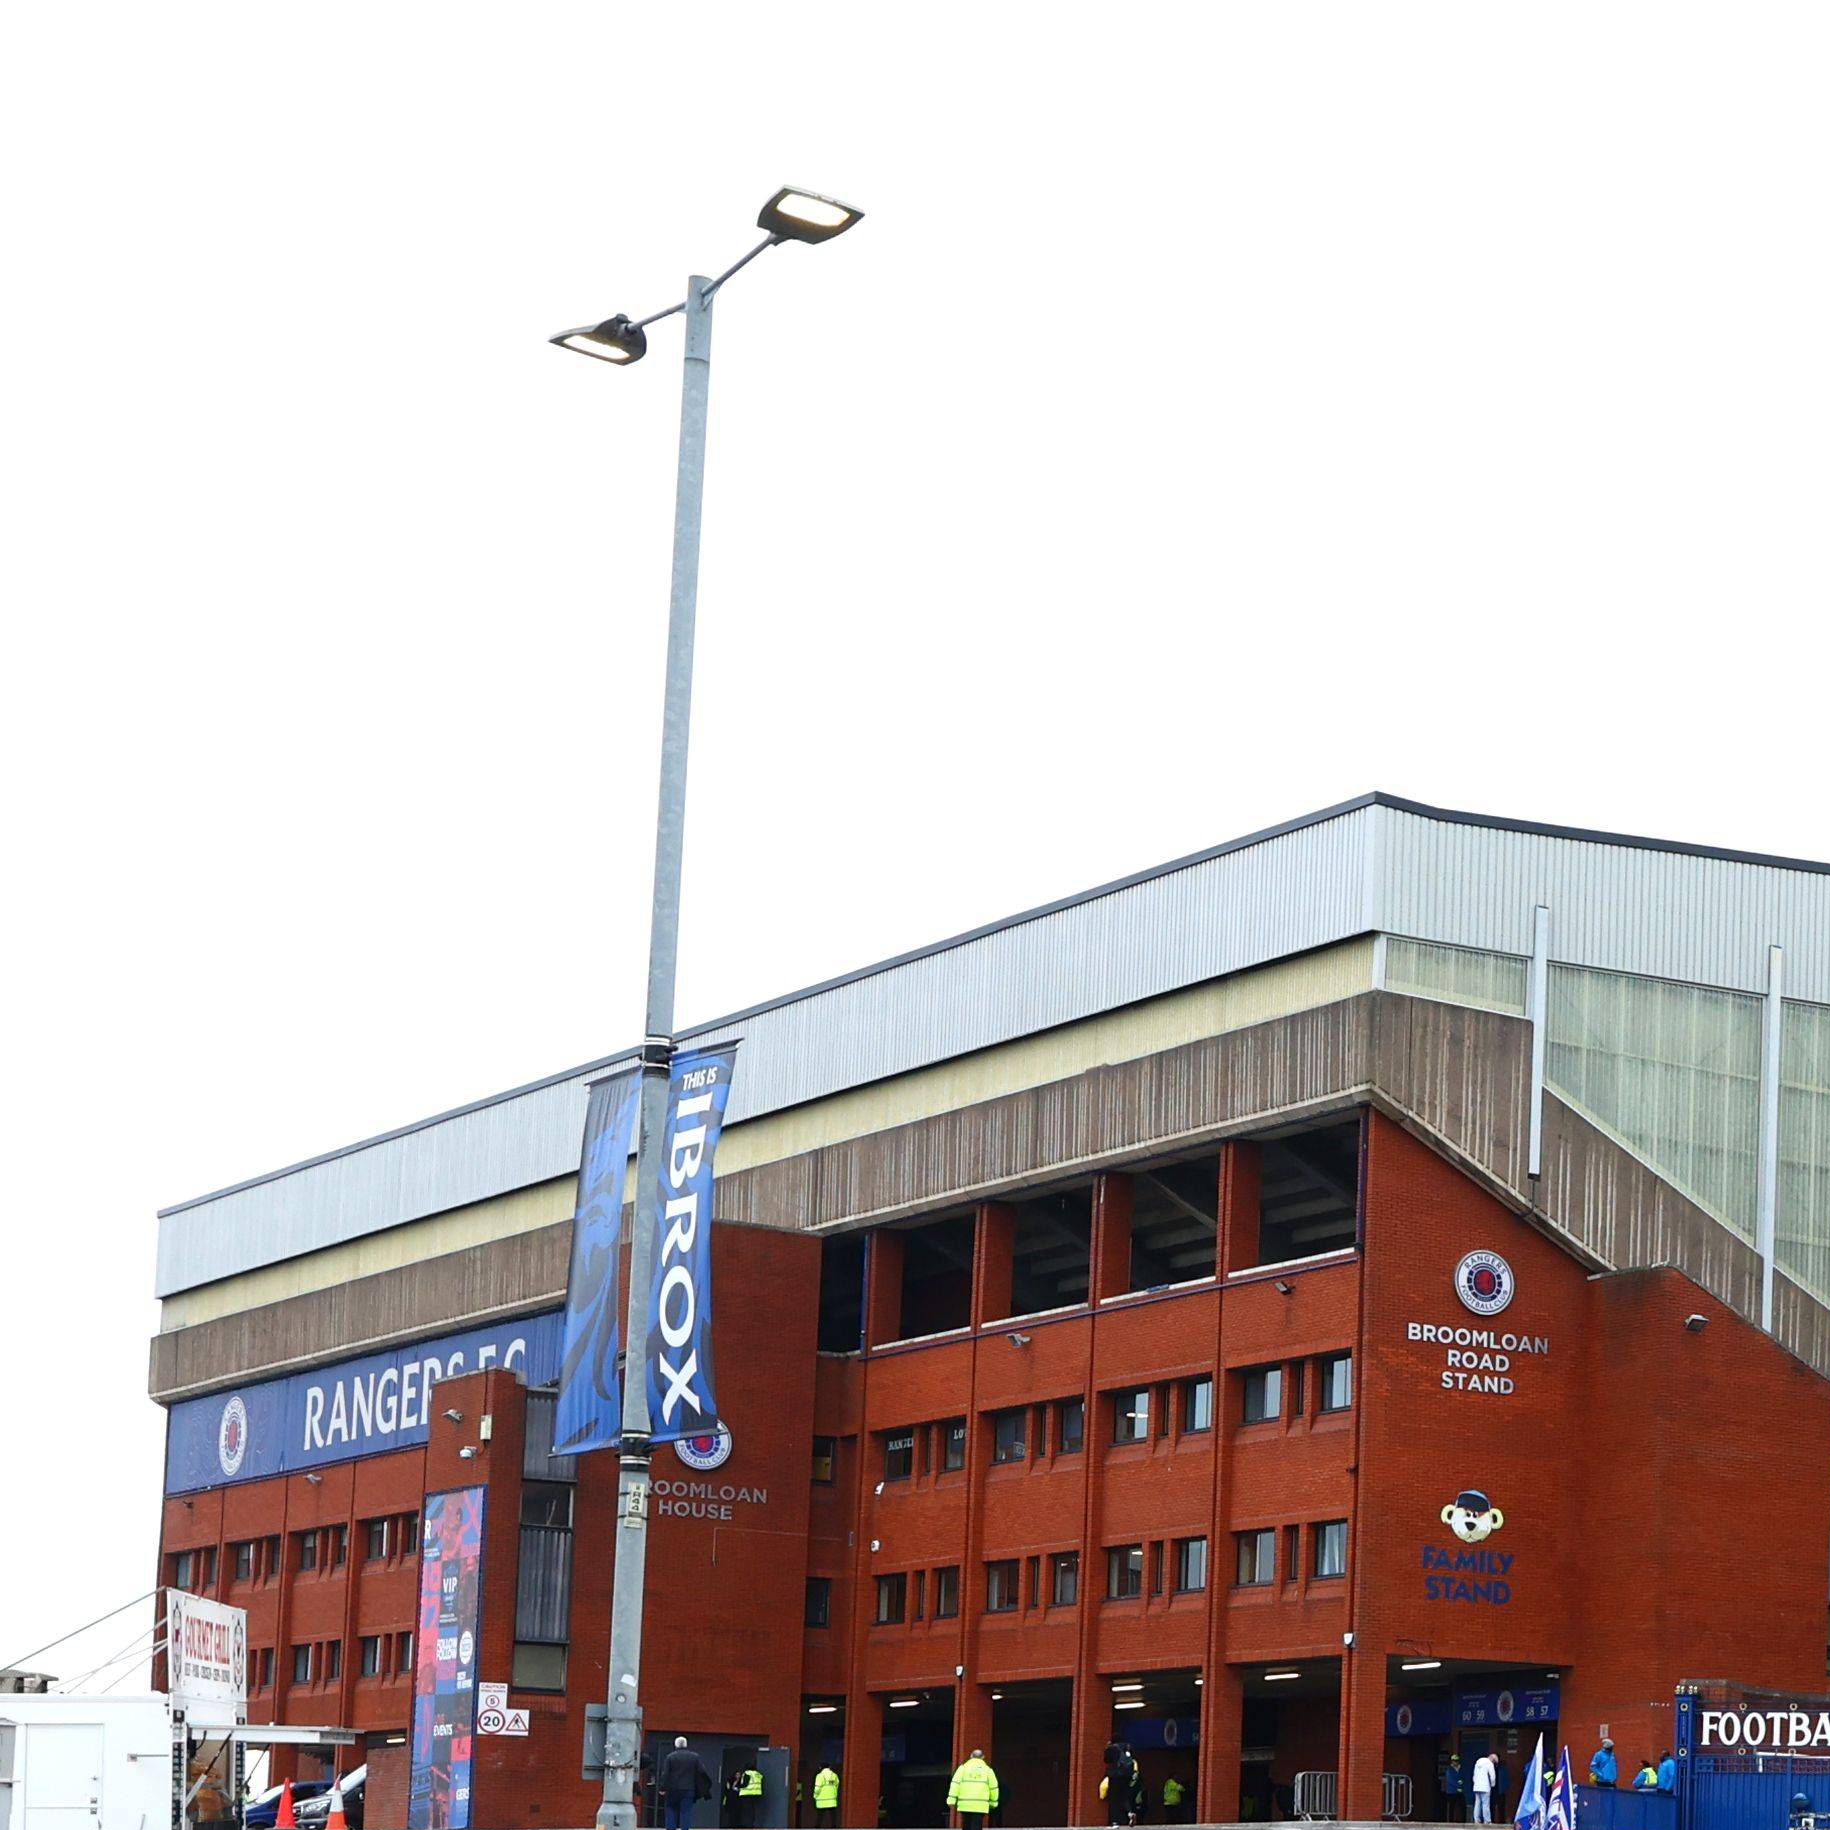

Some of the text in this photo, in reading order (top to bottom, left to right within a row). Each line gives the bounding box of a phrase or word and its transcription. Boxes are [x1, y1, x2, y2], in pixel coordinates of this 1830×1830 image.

[682, 1066, 718, 1091] THIS IS
[659, 1091, 714, 1426] IBROX
[1464, 1254, 1507, 1275] RANGERS
[1460, 1284, 1494, 1310] FOOTBALL
[1493, 1289, 1508, 1308] CLUB
[1407, 1322, 1549, 1354] BROOMLOAN
[1447, 1349, 1510, 1372] ROAD
[1441, 1371, 1515, 1395] STAND
[658, 1499, 734, 1520] HOUSE
[1422, 1544, 1515, 1576] FAMILY
[443, 1577, 458, 1594] VIP
[1424, 1575, 1513, 1606] STAND
[490, 1697, 496, 1705] 5
[433, 1723, 453, 1737] EVENTS
[483, 1715, 500, 1727] 20
